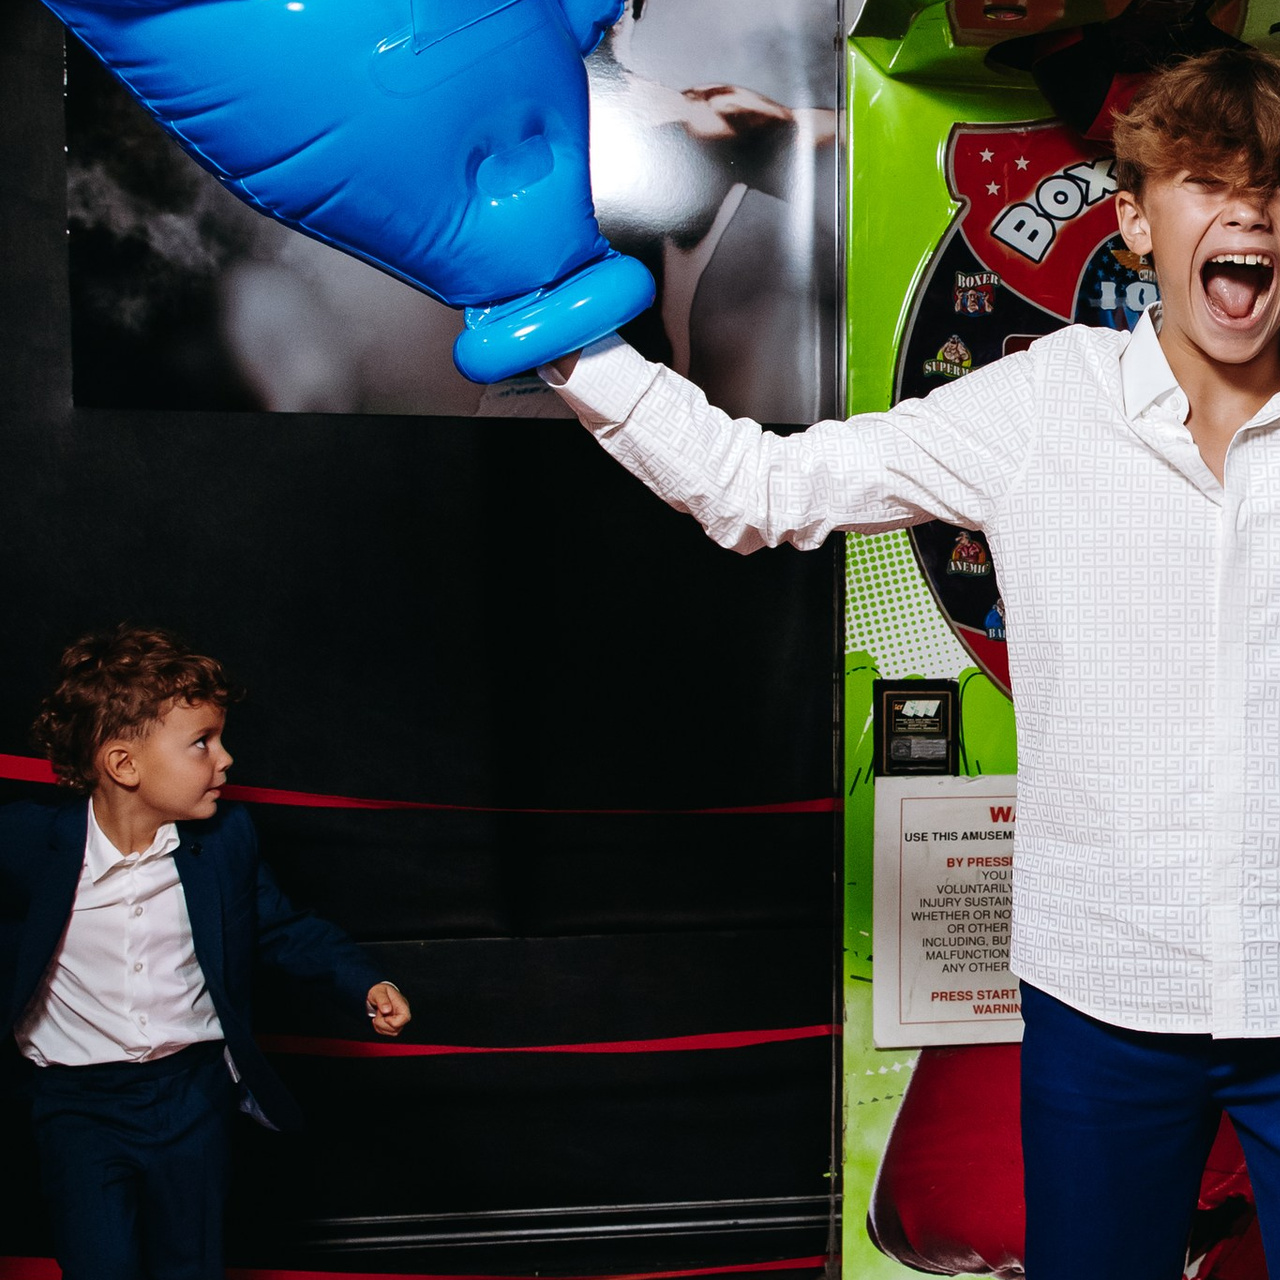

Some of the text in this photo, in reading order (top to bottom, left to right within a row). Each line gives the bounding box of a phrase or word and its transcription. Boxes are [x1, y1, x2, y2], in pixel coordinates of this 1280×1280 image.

[957, 273, 999, 288] BOXER
[925, 361, 971, 376] SUPERM
[950, 561, 989, 574] ANEMIC
[904, 830, 1014, 842] USE THIS AMUSEM
[946, 857, 963, 868] BY
[982, 870, 1007, 880] YOU
[920, 897, 961, 908] INJURY
[911, 910, 970, 921] WHETHER
[972, 910, 991, 920] OR
[947, 922, 1008, 934] OR OTHER
[922, 936, 989, 947] INCLUDING,
[925, 949, 1010, 961] MALFUNCTION
[942, 962, 1009, 973] ANY OTHER
[931, 989, 1017, 1002] PRESS START
